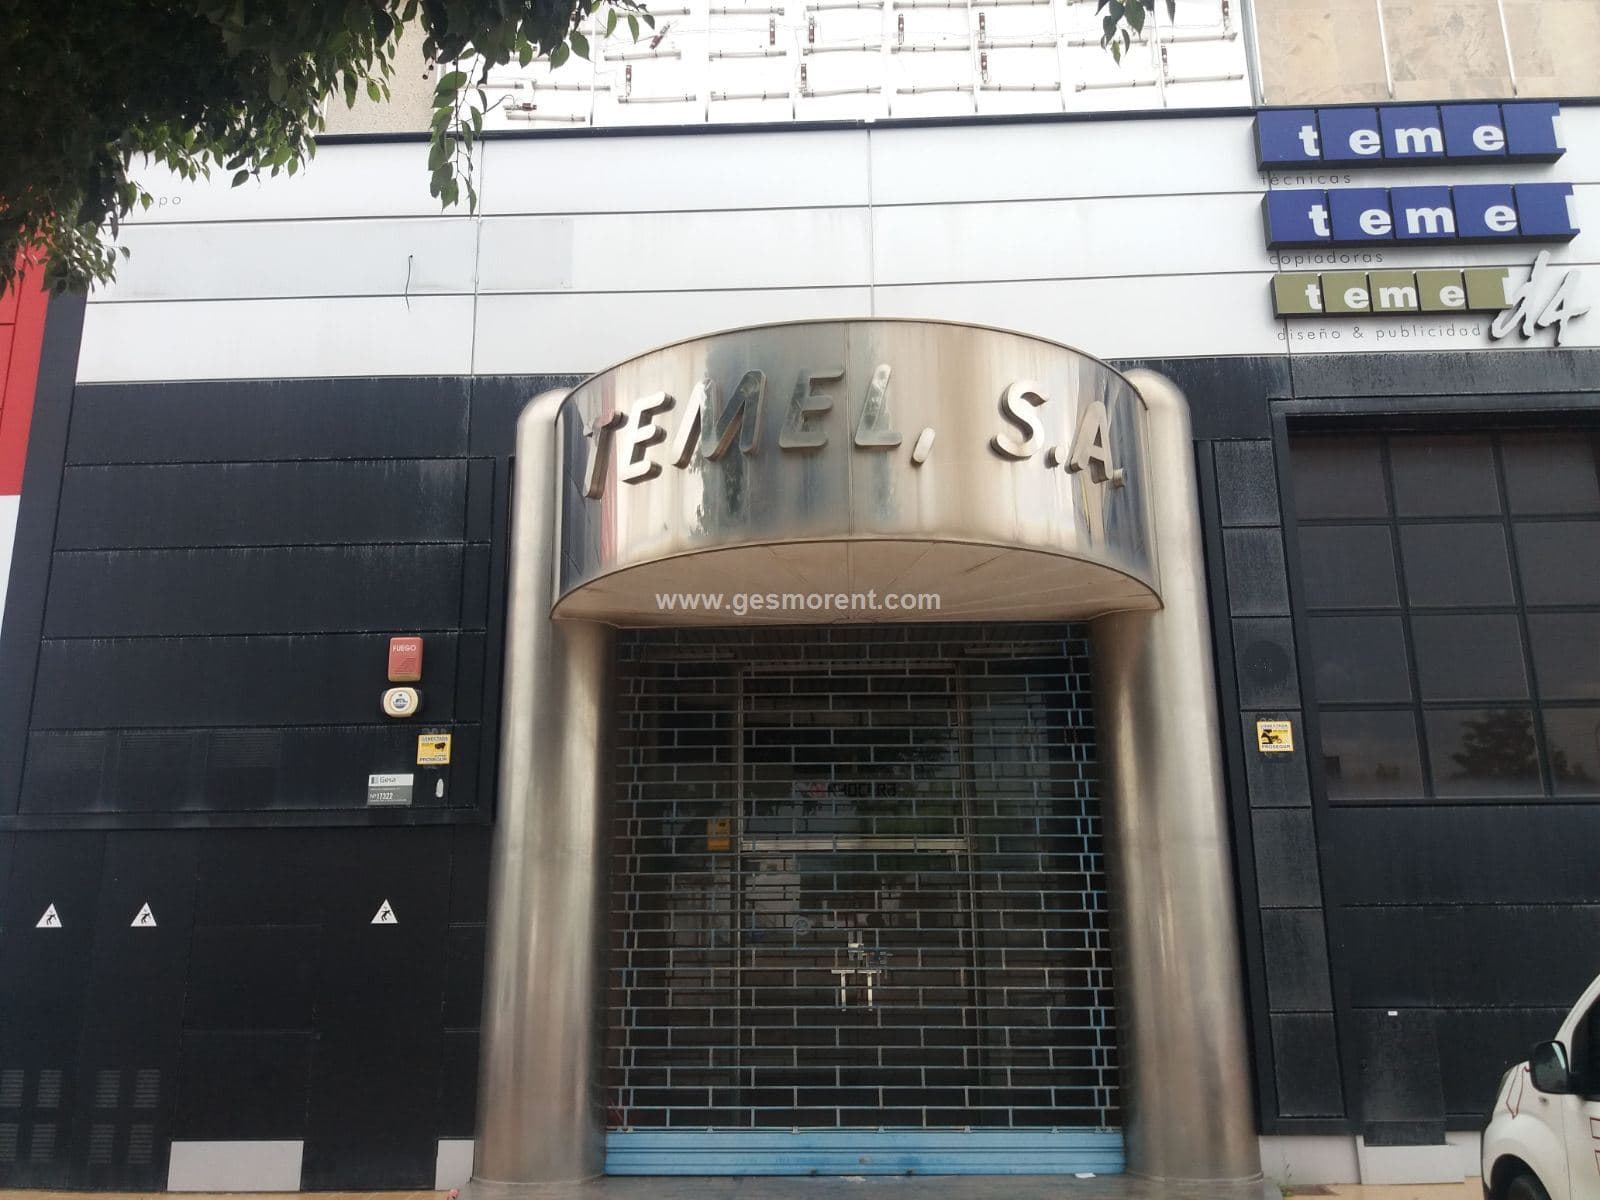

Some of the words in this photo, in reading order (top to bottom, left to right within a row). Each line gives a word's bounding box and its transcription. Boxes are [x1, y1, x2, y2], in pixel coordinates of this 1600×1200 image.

[1260, 173, 1352, 186] técnicas
[1269, 249, 1385, 267] copiadoras
[1277, 326, 1341, 341] diseño
[1352, 326, 1364, 339] &
[1375, 324, 1482, 341] publicidad
[582, 364, 936, 500] TEMEL,
[989, 379, 1127, 488] S.A.
[392, 644, 417, 652] FUEGO
